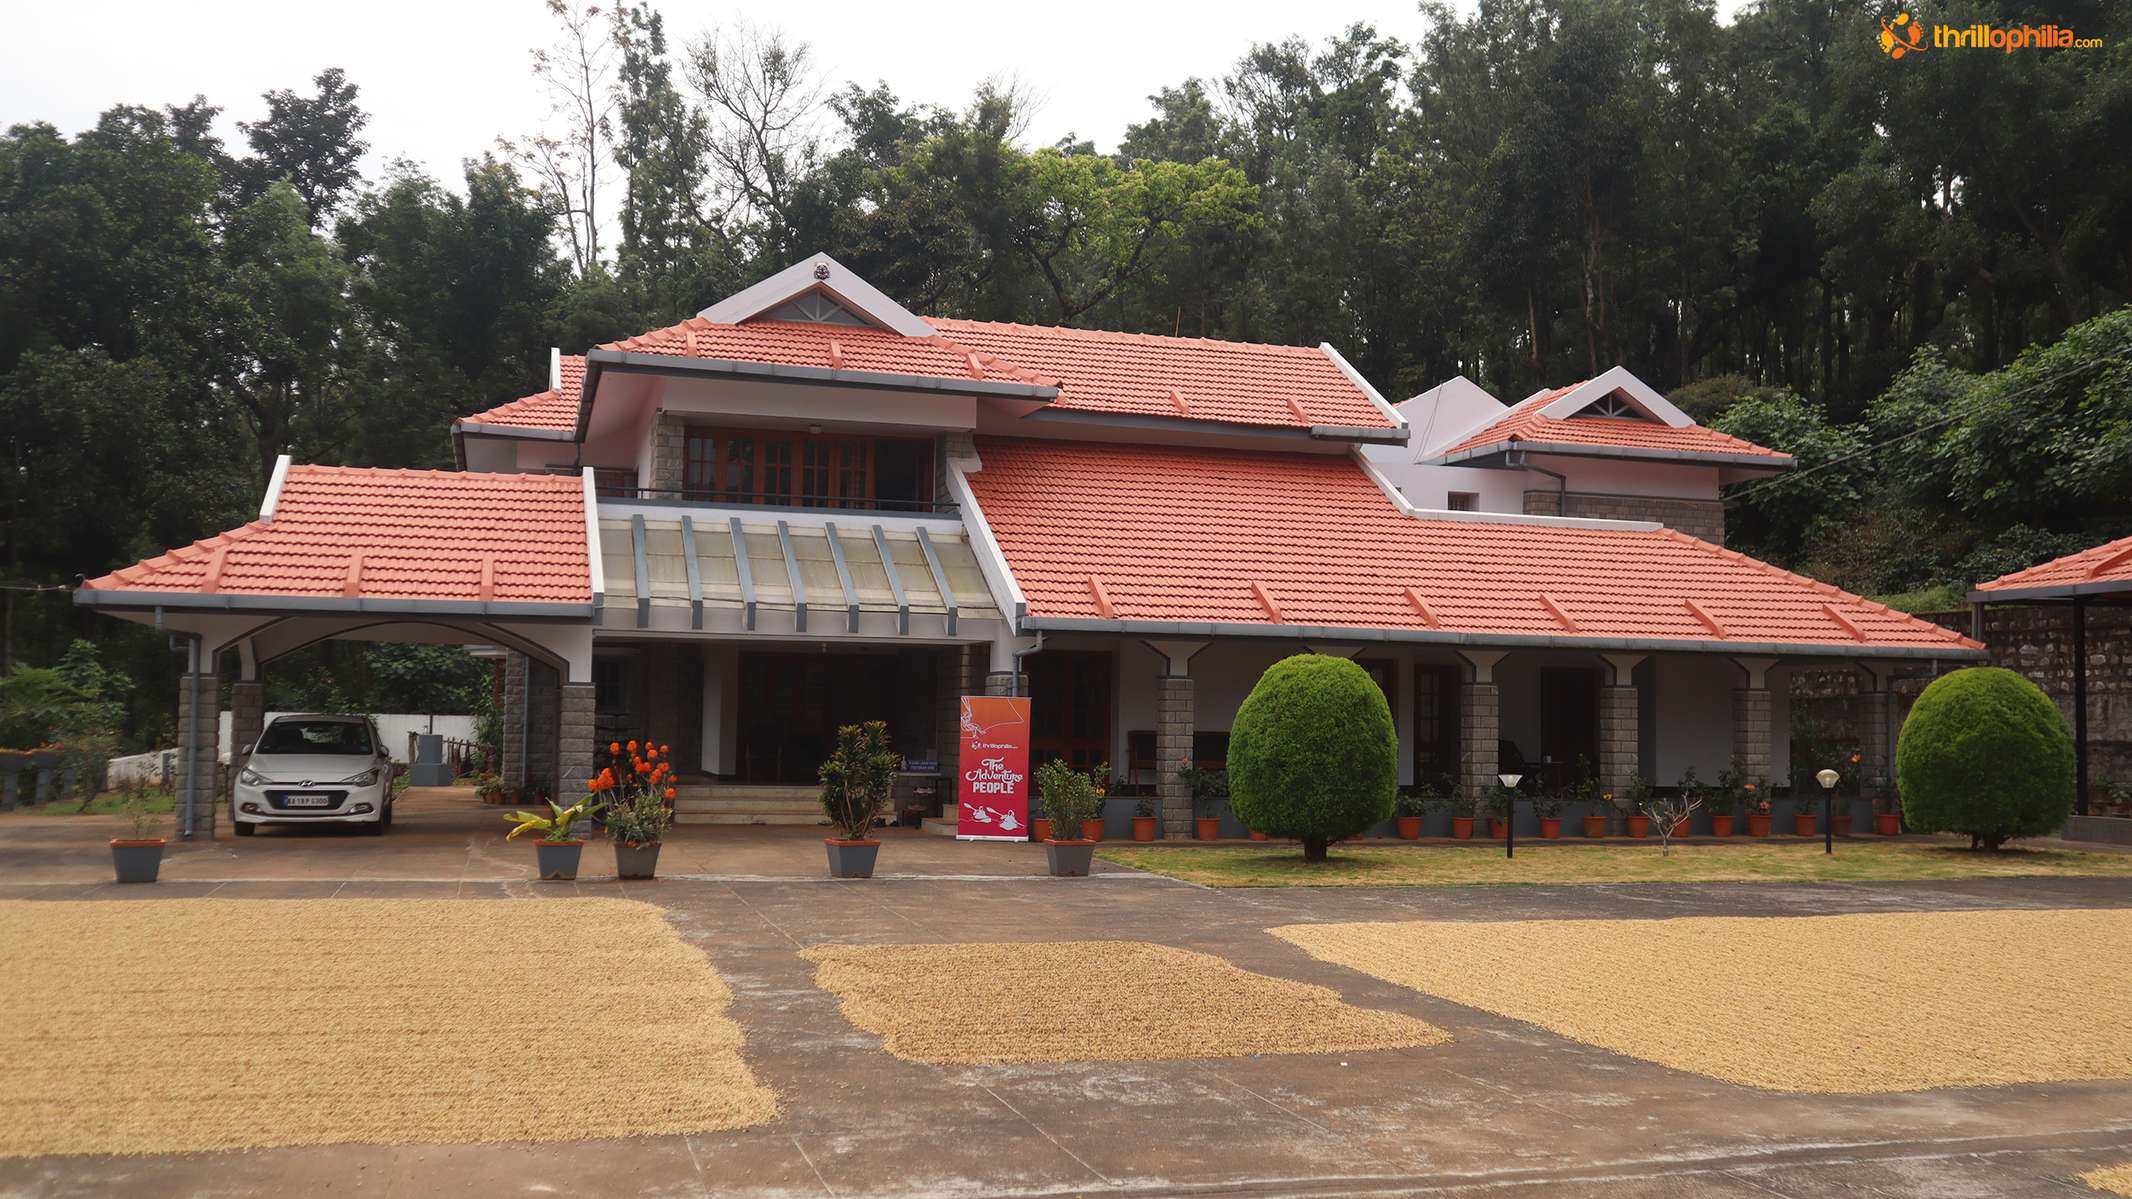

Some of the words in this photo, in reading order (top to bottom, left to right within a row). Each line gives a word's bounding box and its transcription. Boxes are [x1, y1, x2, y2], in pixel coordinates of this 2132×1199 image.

[981, 757, 1004, 771] The
[965, 768, 1023, 784] Adventure
[973, 781, 1014, 794] PEOPLE
